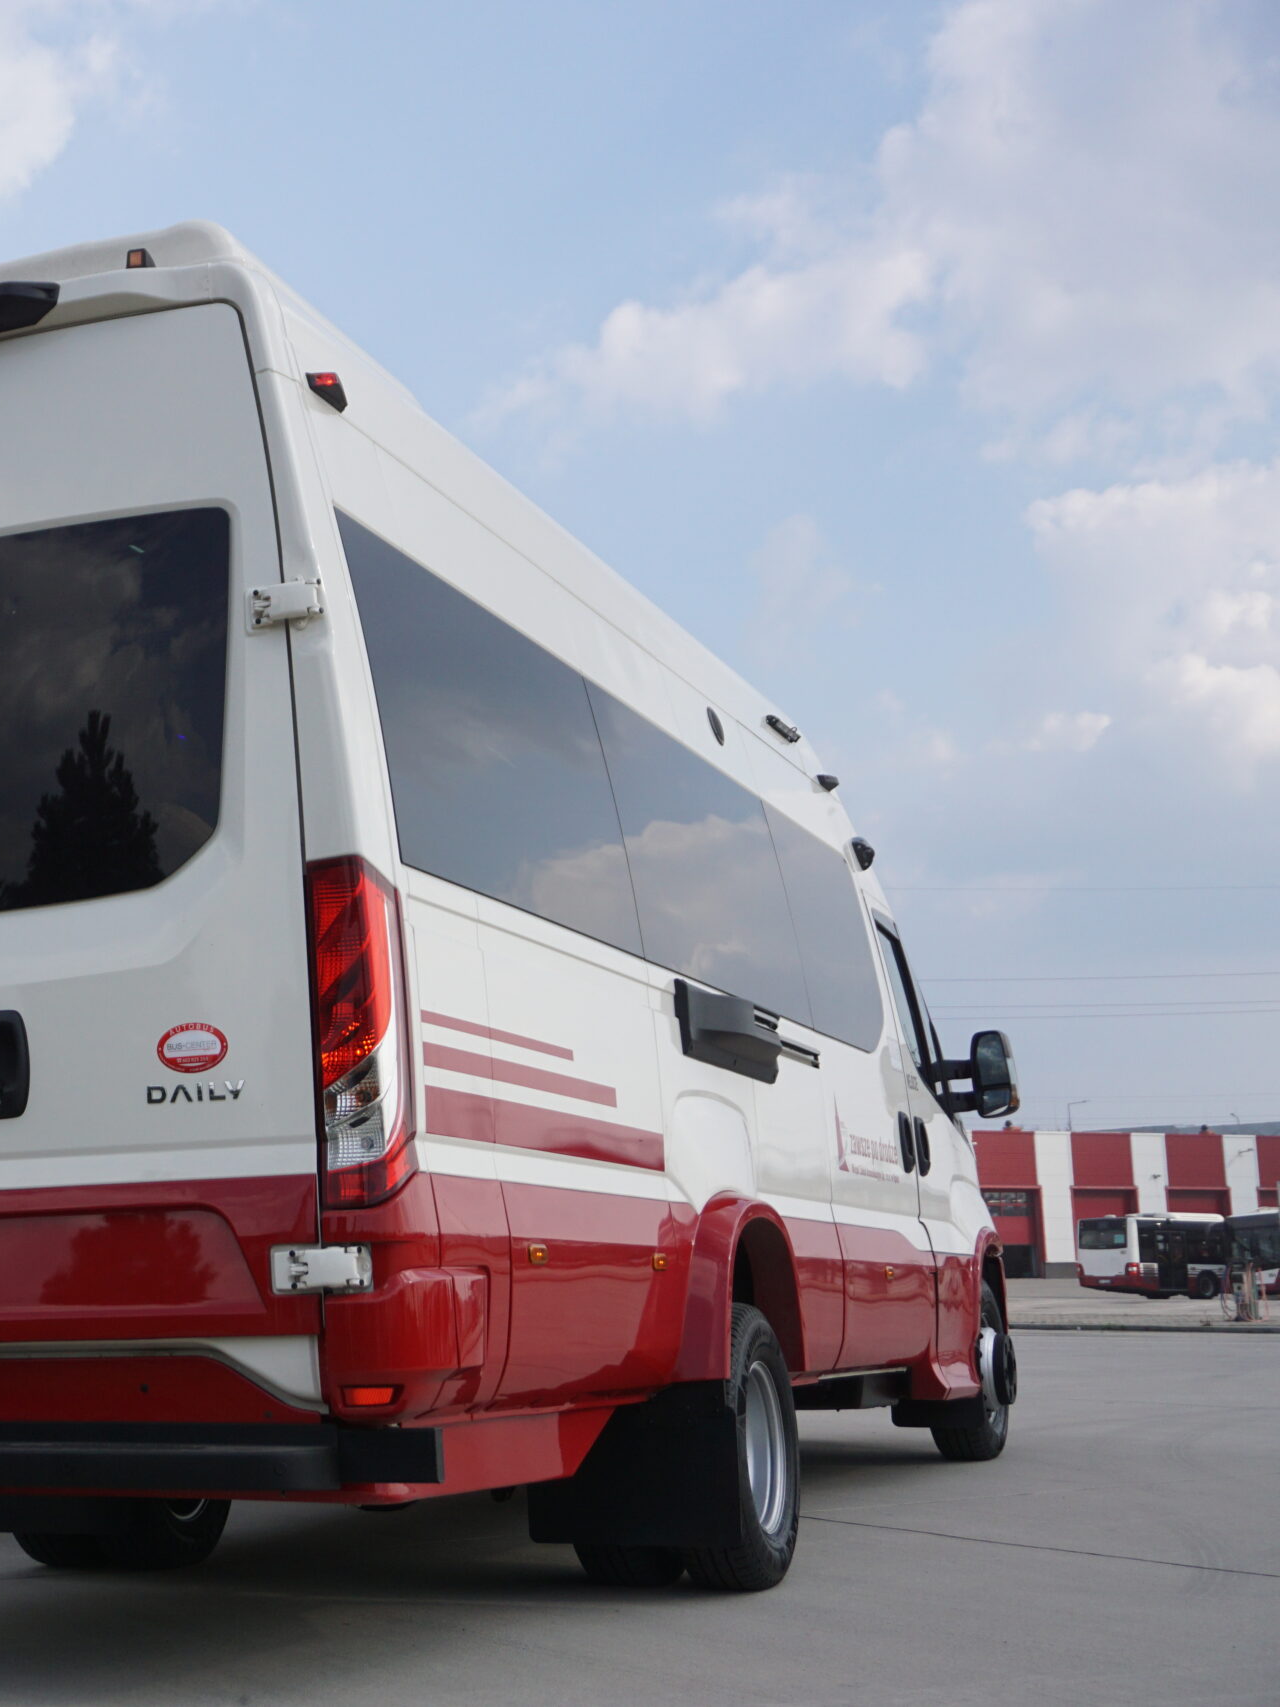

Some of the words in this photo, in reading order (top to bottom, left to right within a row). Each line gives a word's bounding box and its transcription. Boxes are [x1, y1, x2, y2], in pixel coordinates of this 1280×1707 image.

[168, 1023, 215, 1036] AUTOBUS
[166, 1039, 217, 1051] BUS-CENTER
[146, 1079, 245, 1104] DAILY
